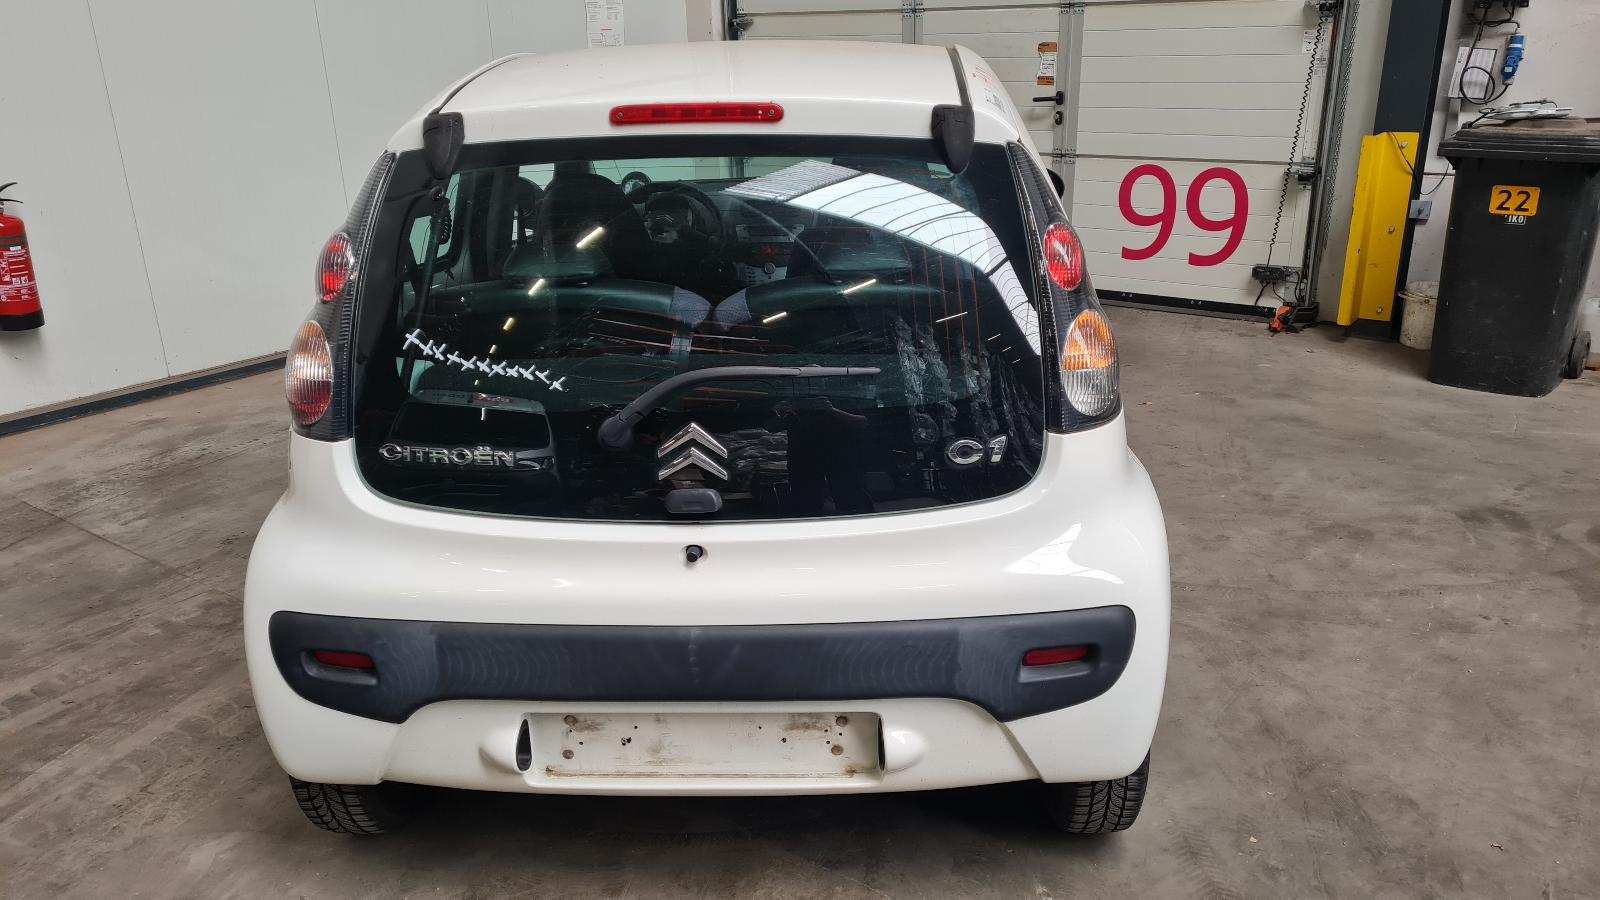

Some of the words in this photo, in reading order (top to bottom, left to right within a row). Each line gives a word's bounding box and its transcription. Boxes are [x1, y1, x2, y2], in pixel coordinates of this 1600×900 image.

[1496, 189, 1531, 212] 22
[1119, 164, 1249, 267] 99
[1504, 215, 1524, 223] IKO
[378, 443, 514, 467] CITROËN
[948, 435, 1007, 465] C1
